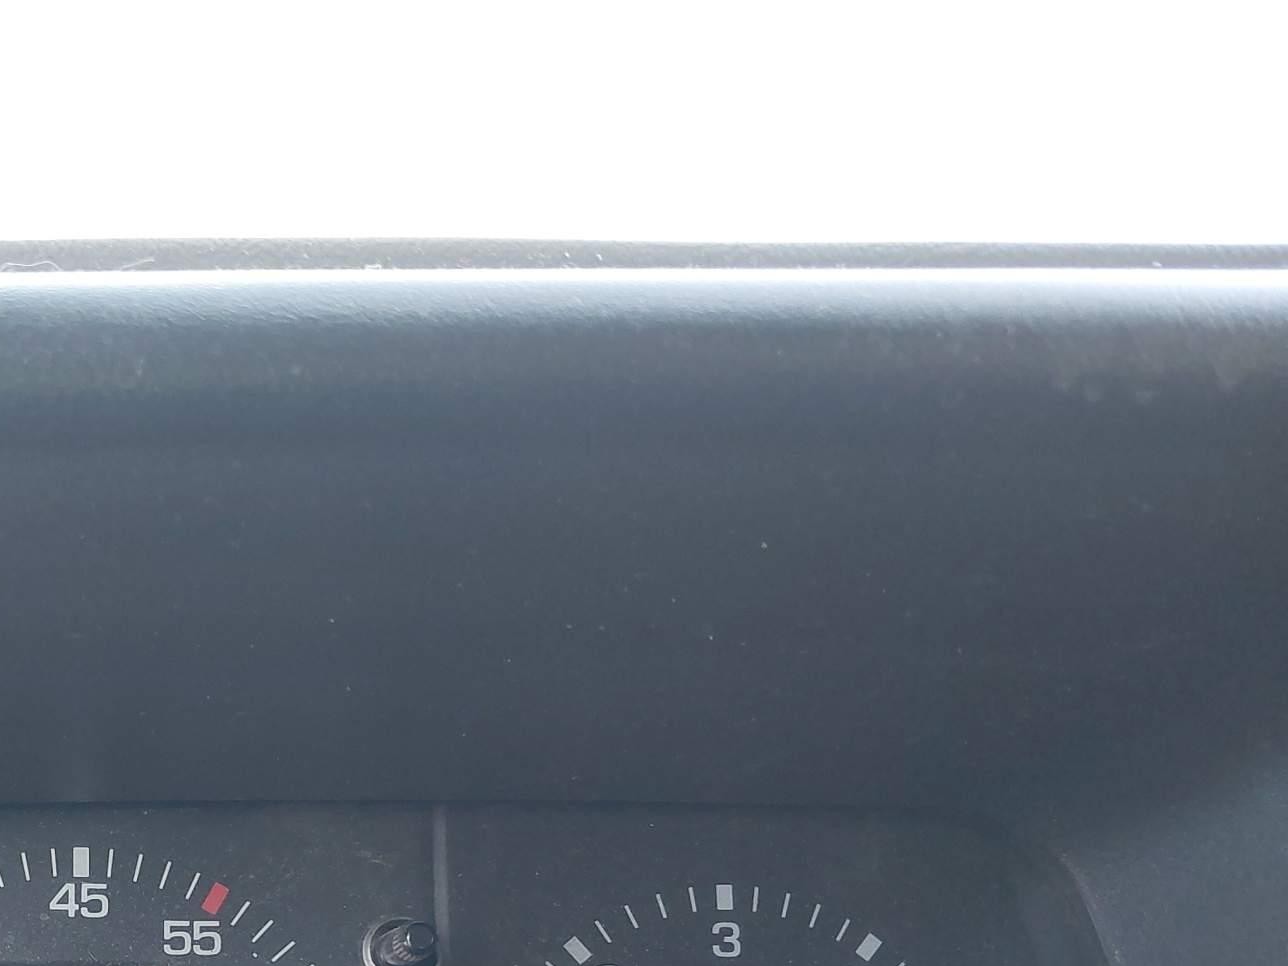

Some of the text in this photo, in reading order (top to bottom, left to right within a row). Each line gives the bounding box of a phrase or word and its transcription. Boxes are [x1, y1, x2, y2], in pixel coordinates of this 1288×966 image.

[50, 883, 109, 917] 45
[163, 921, 221, 956] 55
[711, 922, 741, 957] 3
